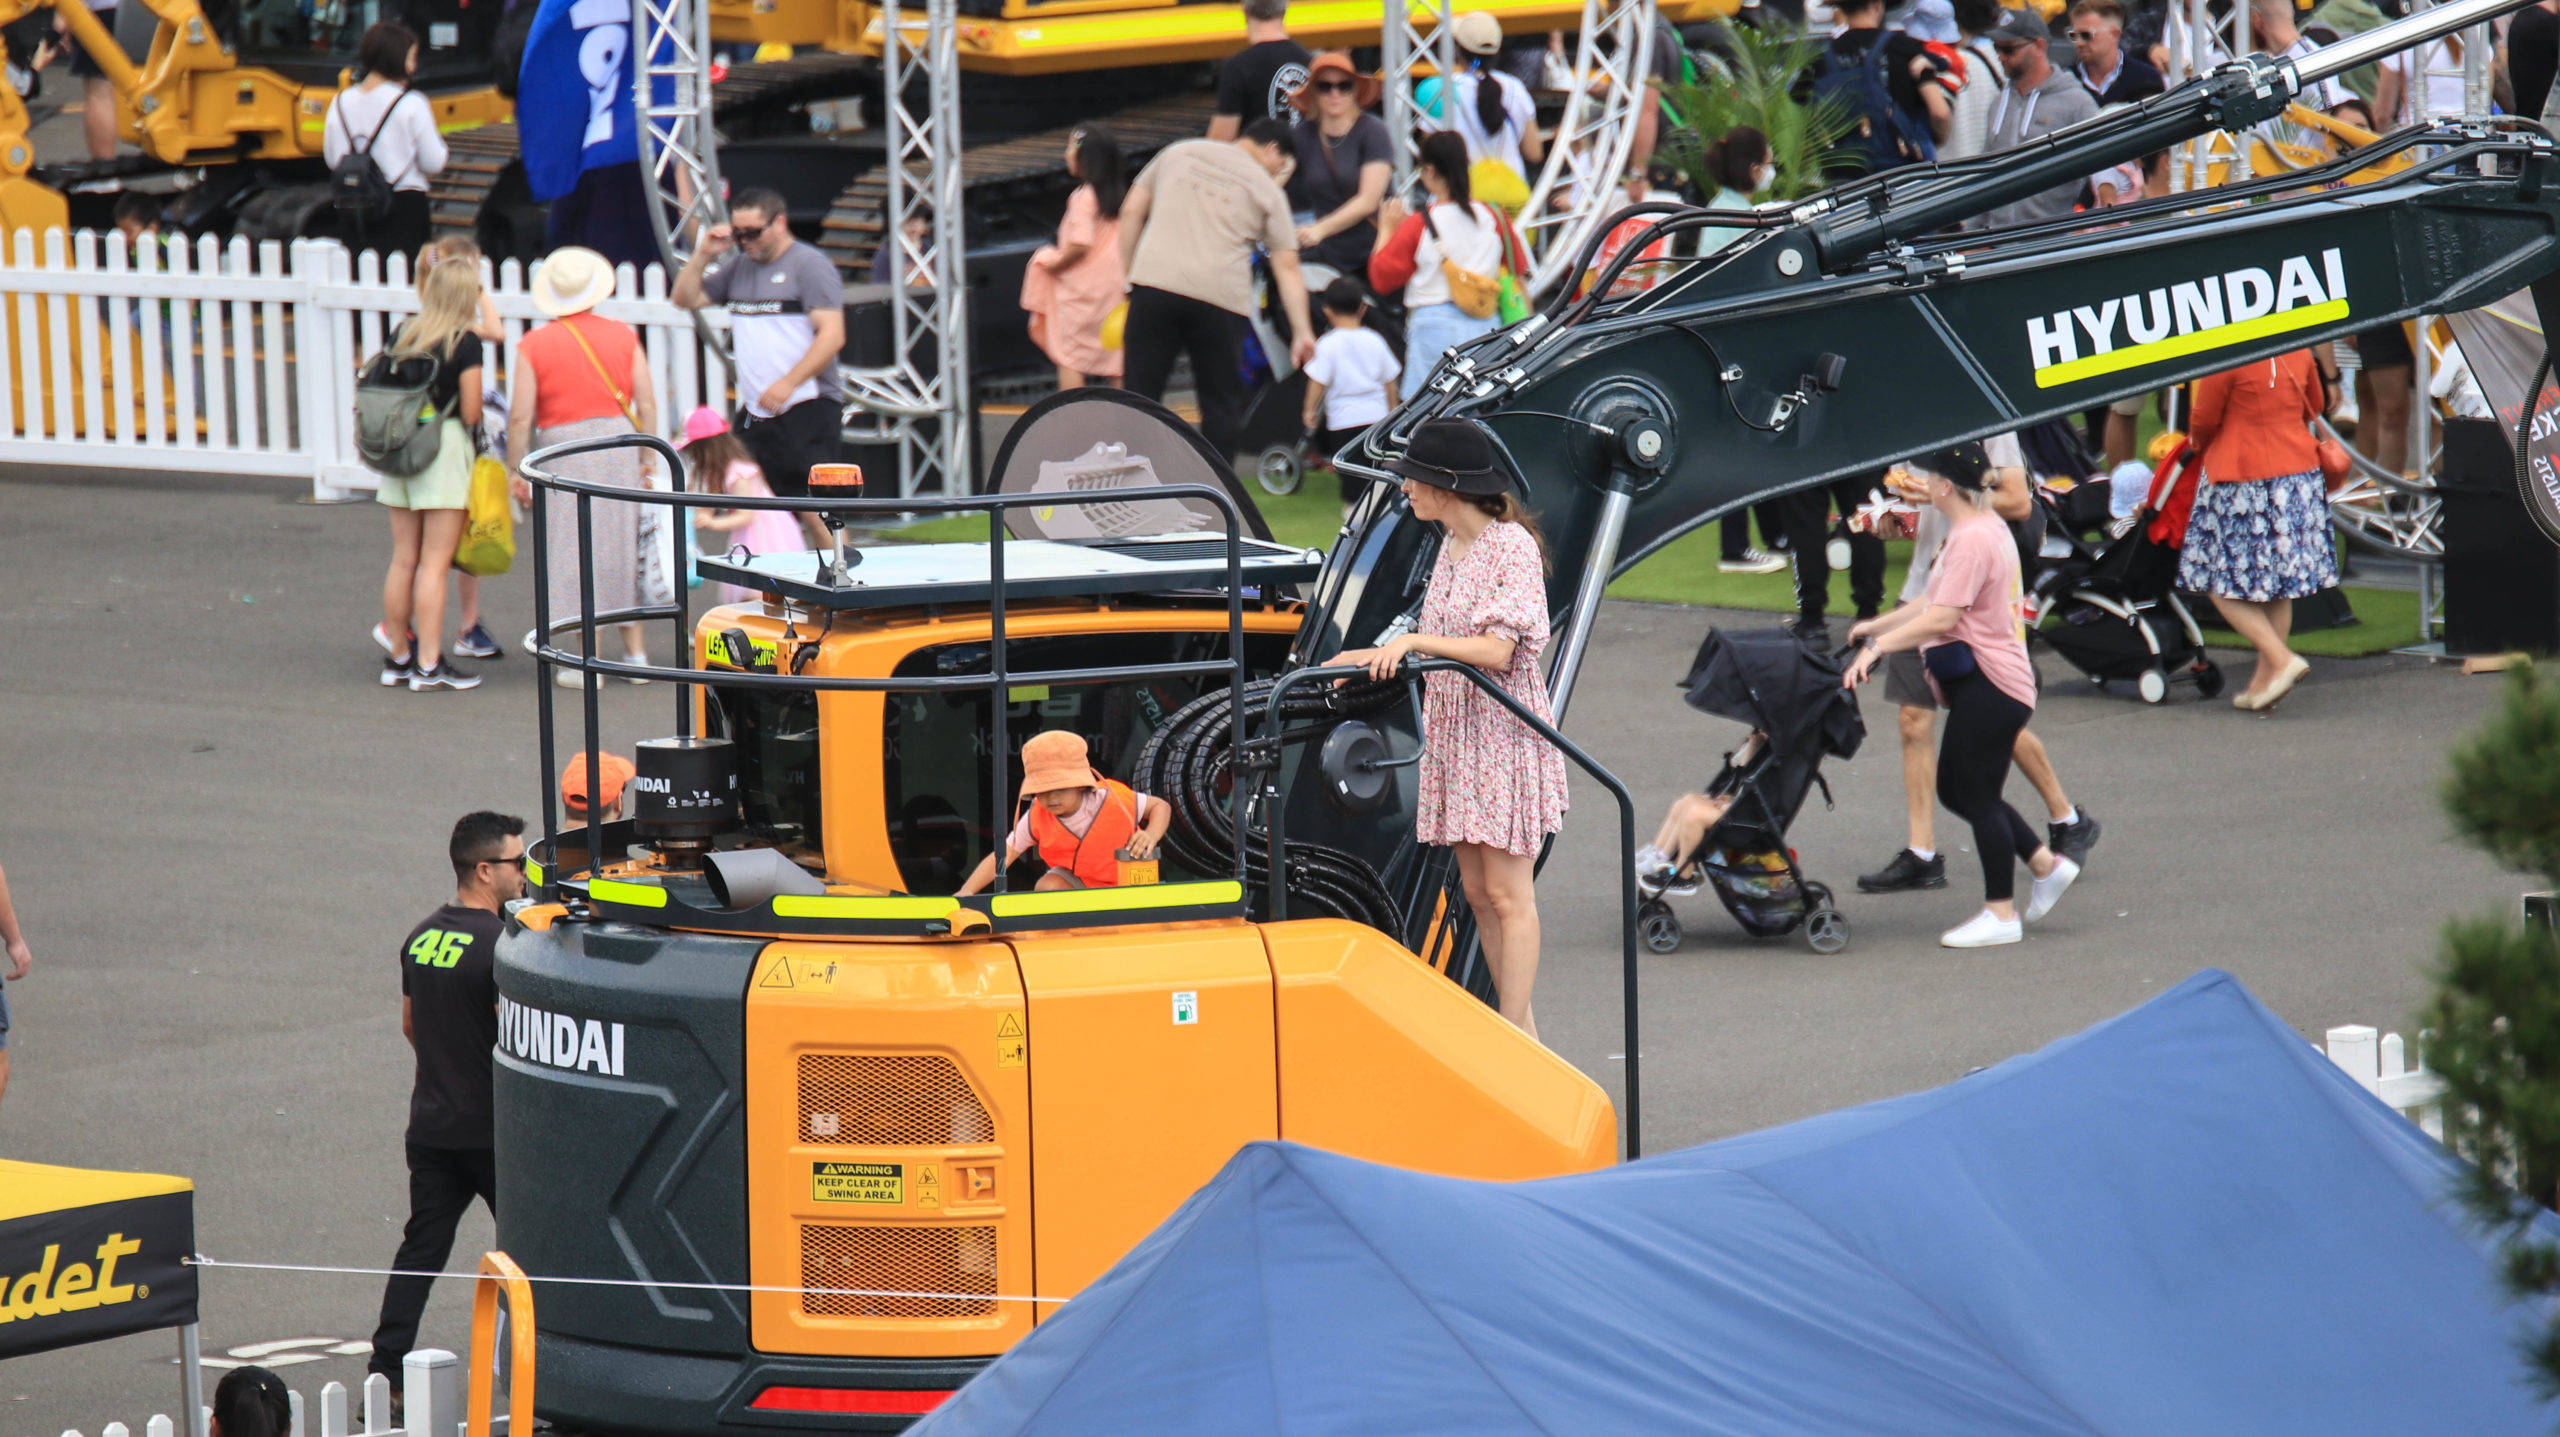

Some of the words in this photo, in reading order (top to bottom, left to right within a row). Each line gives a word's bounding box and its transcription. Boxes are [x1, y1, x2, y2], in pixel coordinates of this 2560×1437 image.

[2027, 247, 2348, 370] HYUNDAI
[409, 928, 474, 969] 46
[498, 993, 625, 1077] HYUNDAI
[817, 1177, 843, 1188] KEEP
[847, 1178, 880, 1188] CLEAR
[884, 1179, 897, 1188] OF
[836, 1164, 893, 1175] WARNING
[827, 1190, 861, 1199] SWING
[864, 1191, 895, 1200] AREA
